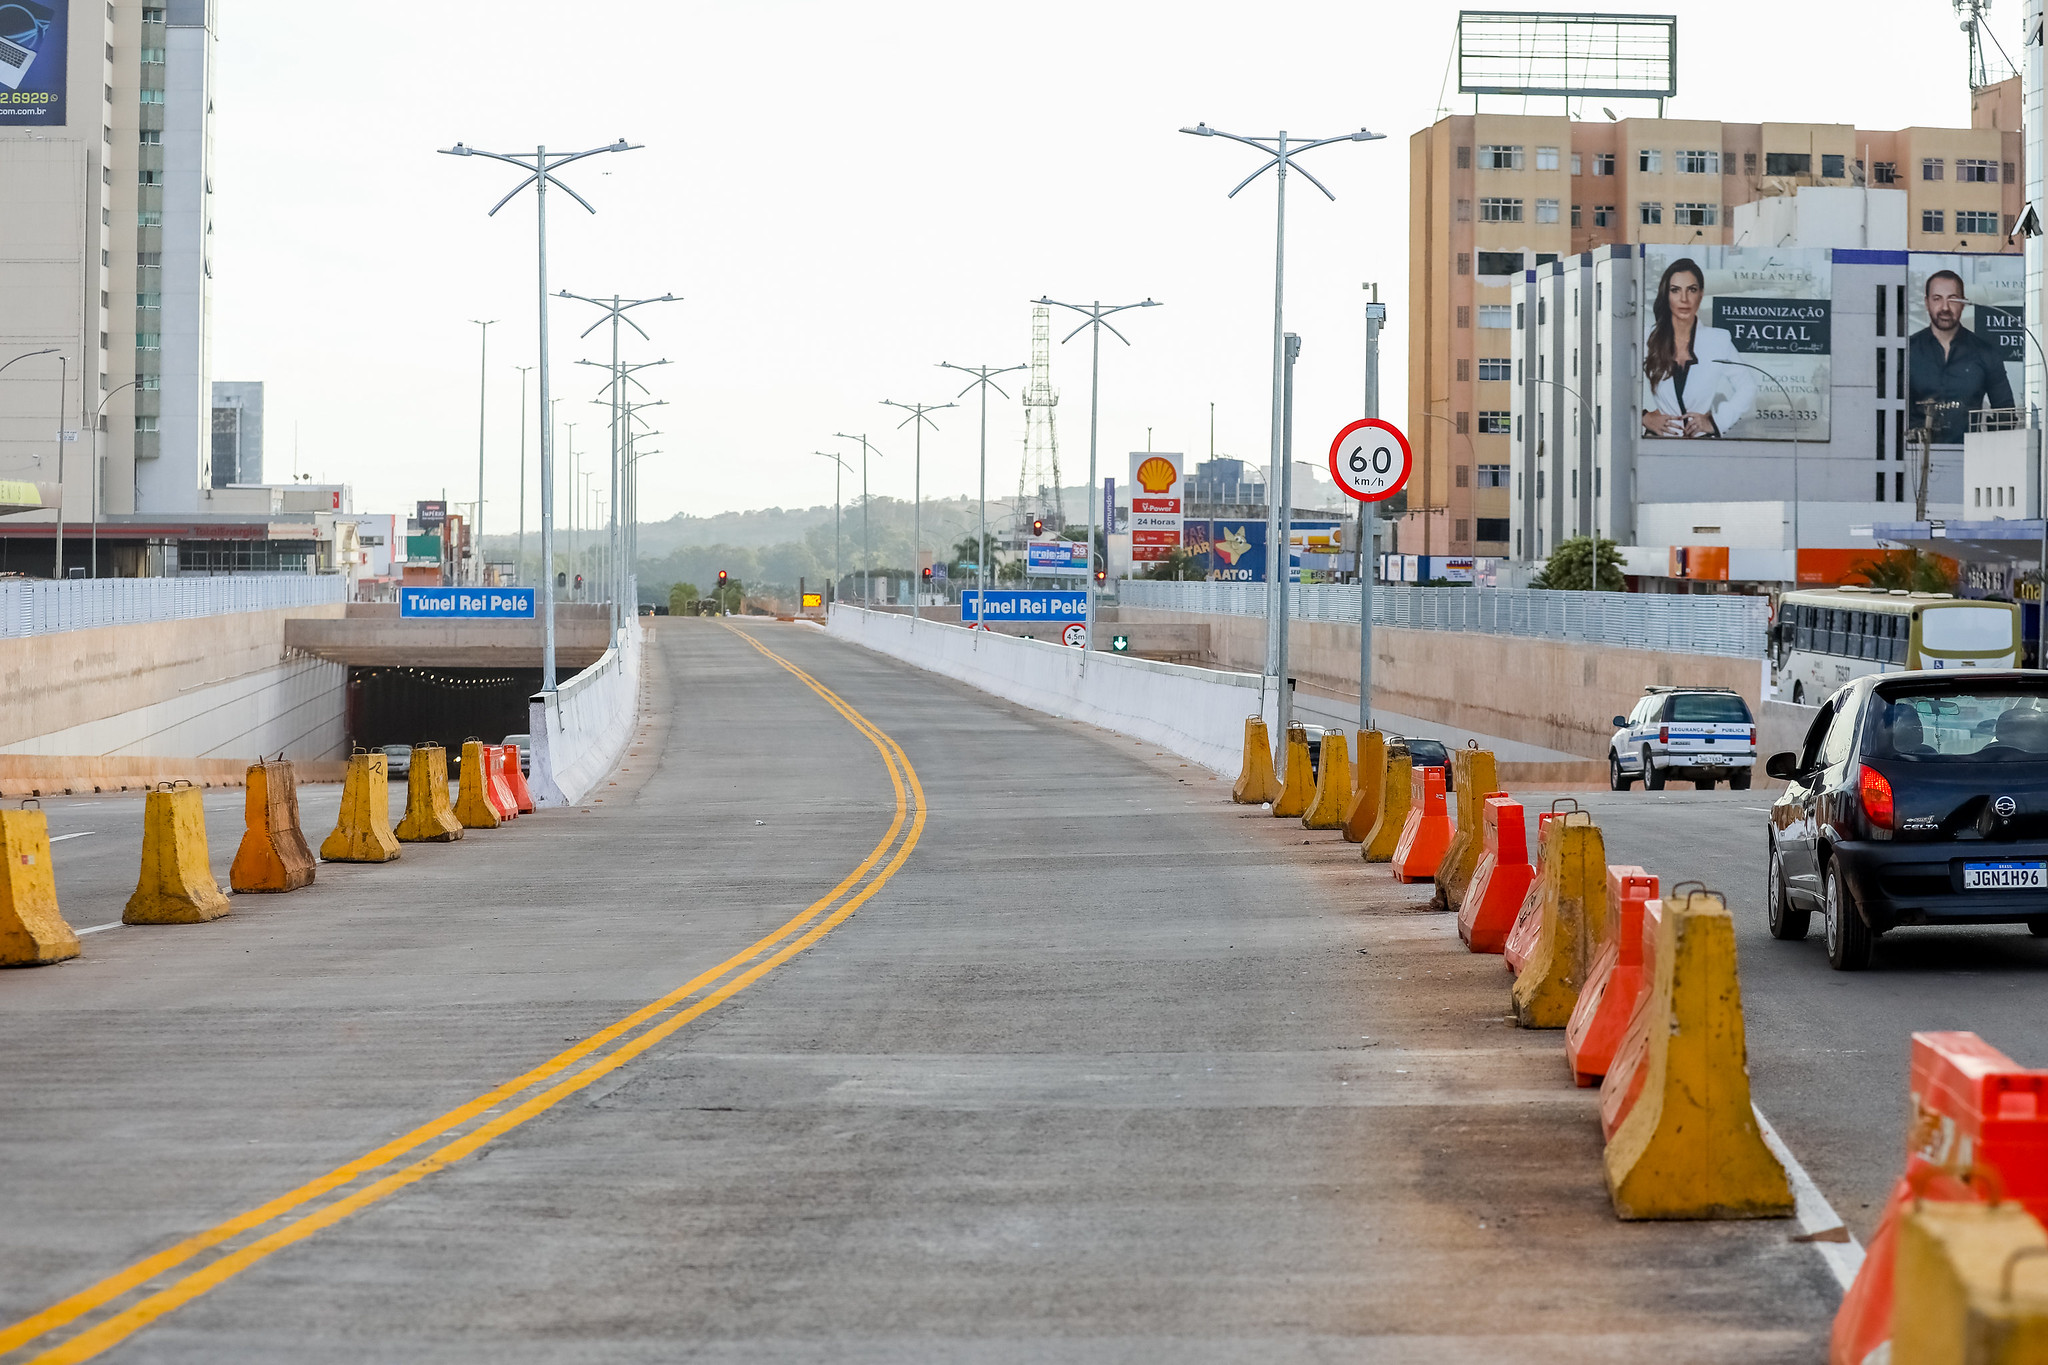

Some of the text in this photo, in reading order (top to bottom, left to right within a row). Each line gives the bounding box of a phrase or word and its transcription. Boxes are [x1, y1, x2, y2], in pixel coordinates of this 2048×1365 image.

[1734, 271, 1812, 281] IMPLANTEC
[1722, 306, 1825, 319] HARMONIZAÇÃO
[1735, 324, 1811, 341] FACIAL
[1756, 409, 1818, 420] 3563-3333
[1349, 446, 1392, 474] 60
[1354, 476, 1384, 487] km/h
[1142, 502, 1173, 511] V-Power
[408, 594, 528, 611] Túnel Rei Pelé
[1020, 598, 1047, 614] Rei
[1051, 599, 1087, 614] Pelé
[1903, 823, 1939, 831] CELTA
[1972, 870, 2039, 886] JGN1H96
